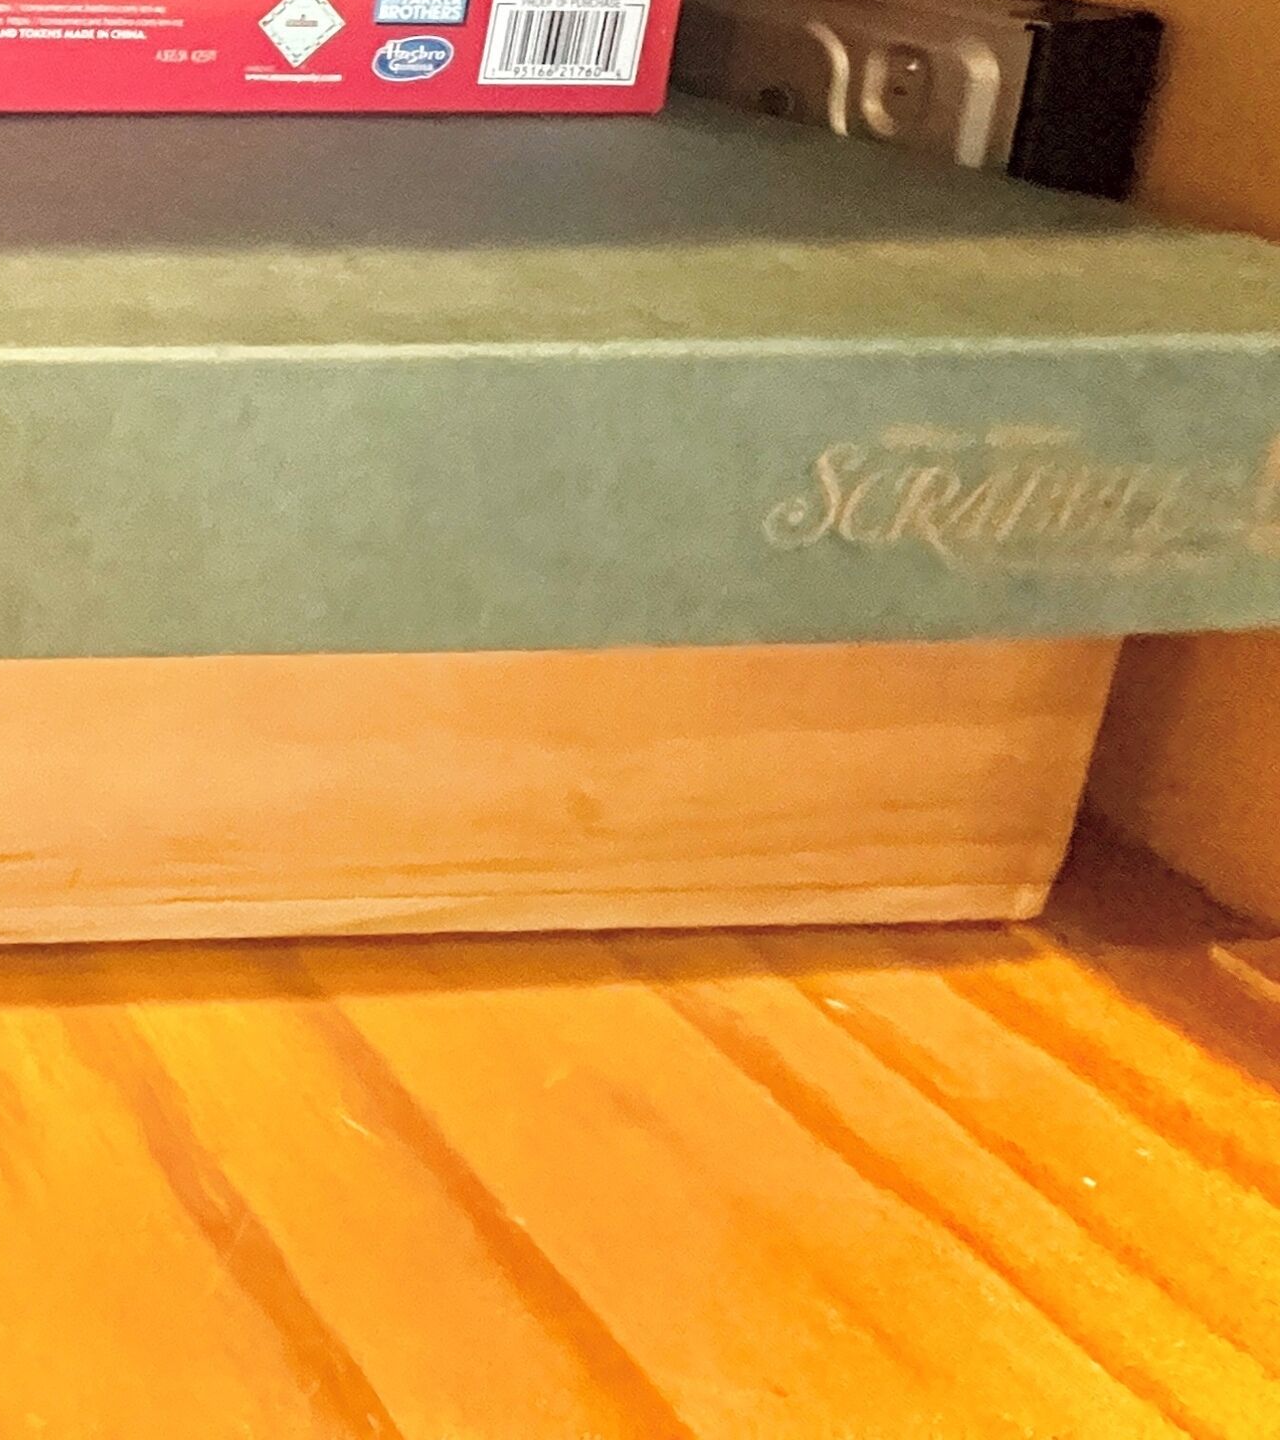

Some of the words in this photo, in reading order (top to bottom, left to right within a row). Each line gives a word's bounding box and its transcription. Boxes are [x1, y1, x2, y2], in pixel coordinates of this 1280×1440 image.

[378, 5, 463, 21] BROTHERS
[18, 27, 63, 40] TOKENS
[64, 28, 96, 40] MADE
[96, 28, 110, 40] IN
[384, 41, 447, 64] Hasbro
[513, 66, 554, 78] 95166
